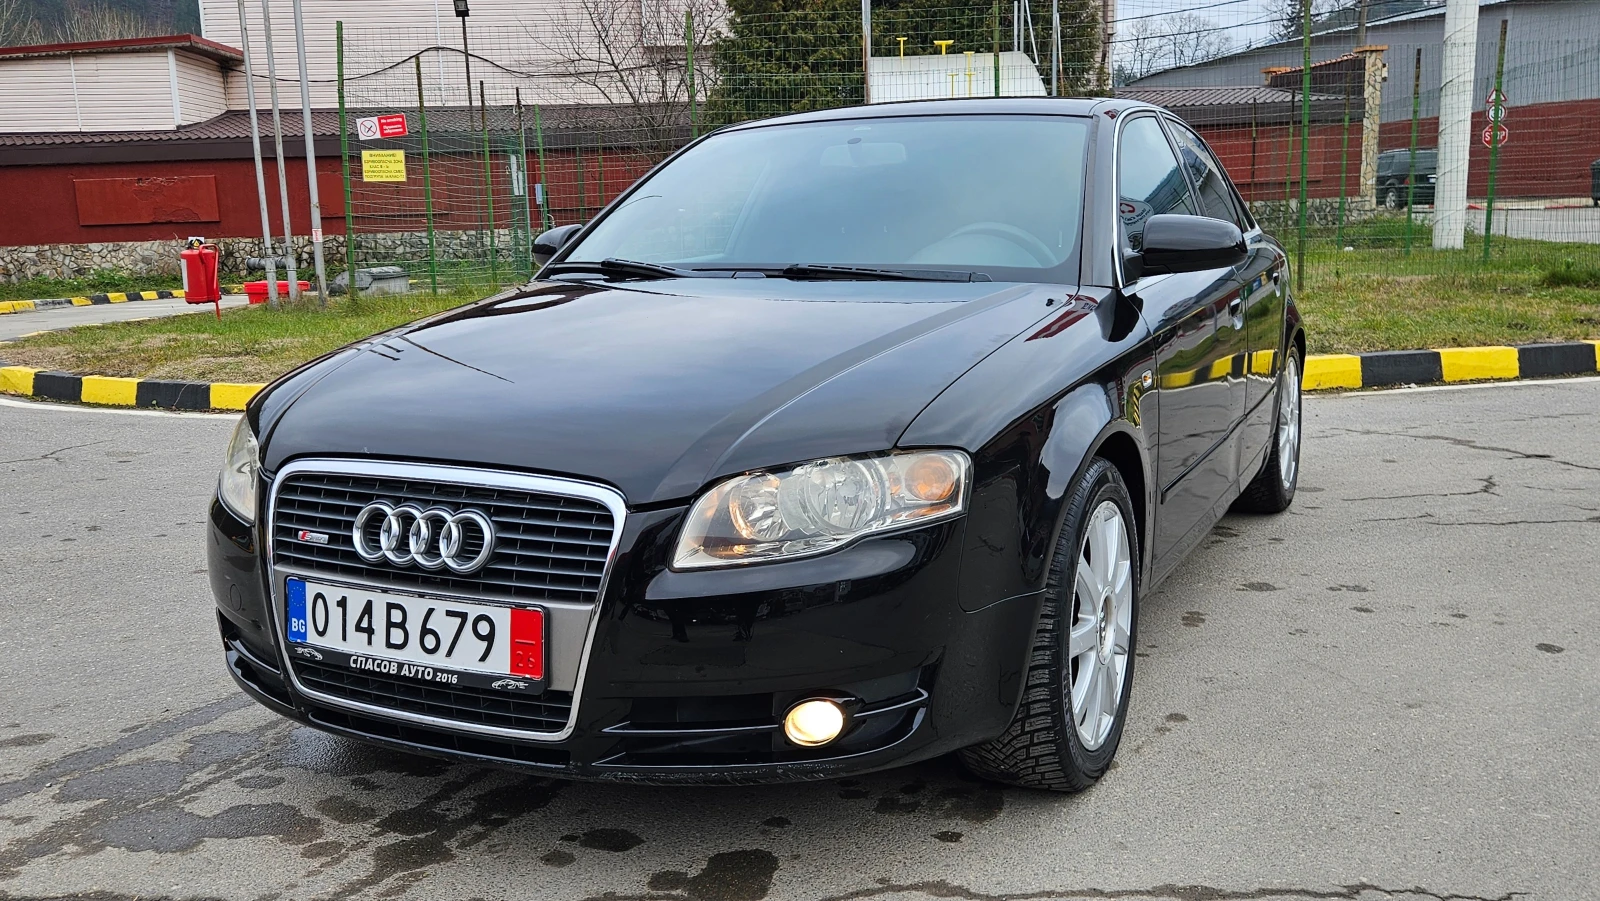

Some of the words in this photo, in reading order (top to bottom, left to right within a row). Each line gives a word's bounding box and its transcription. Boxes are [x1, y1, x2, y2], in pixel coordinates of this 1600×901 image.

[292, 618, 306, 633] BG
[516, 651, 536, 669] 26
[350, 656, 398, 675] СПАСОВ
[401, 664, 434, 680] АУТО
[436, 671, 458, 684] 2016
